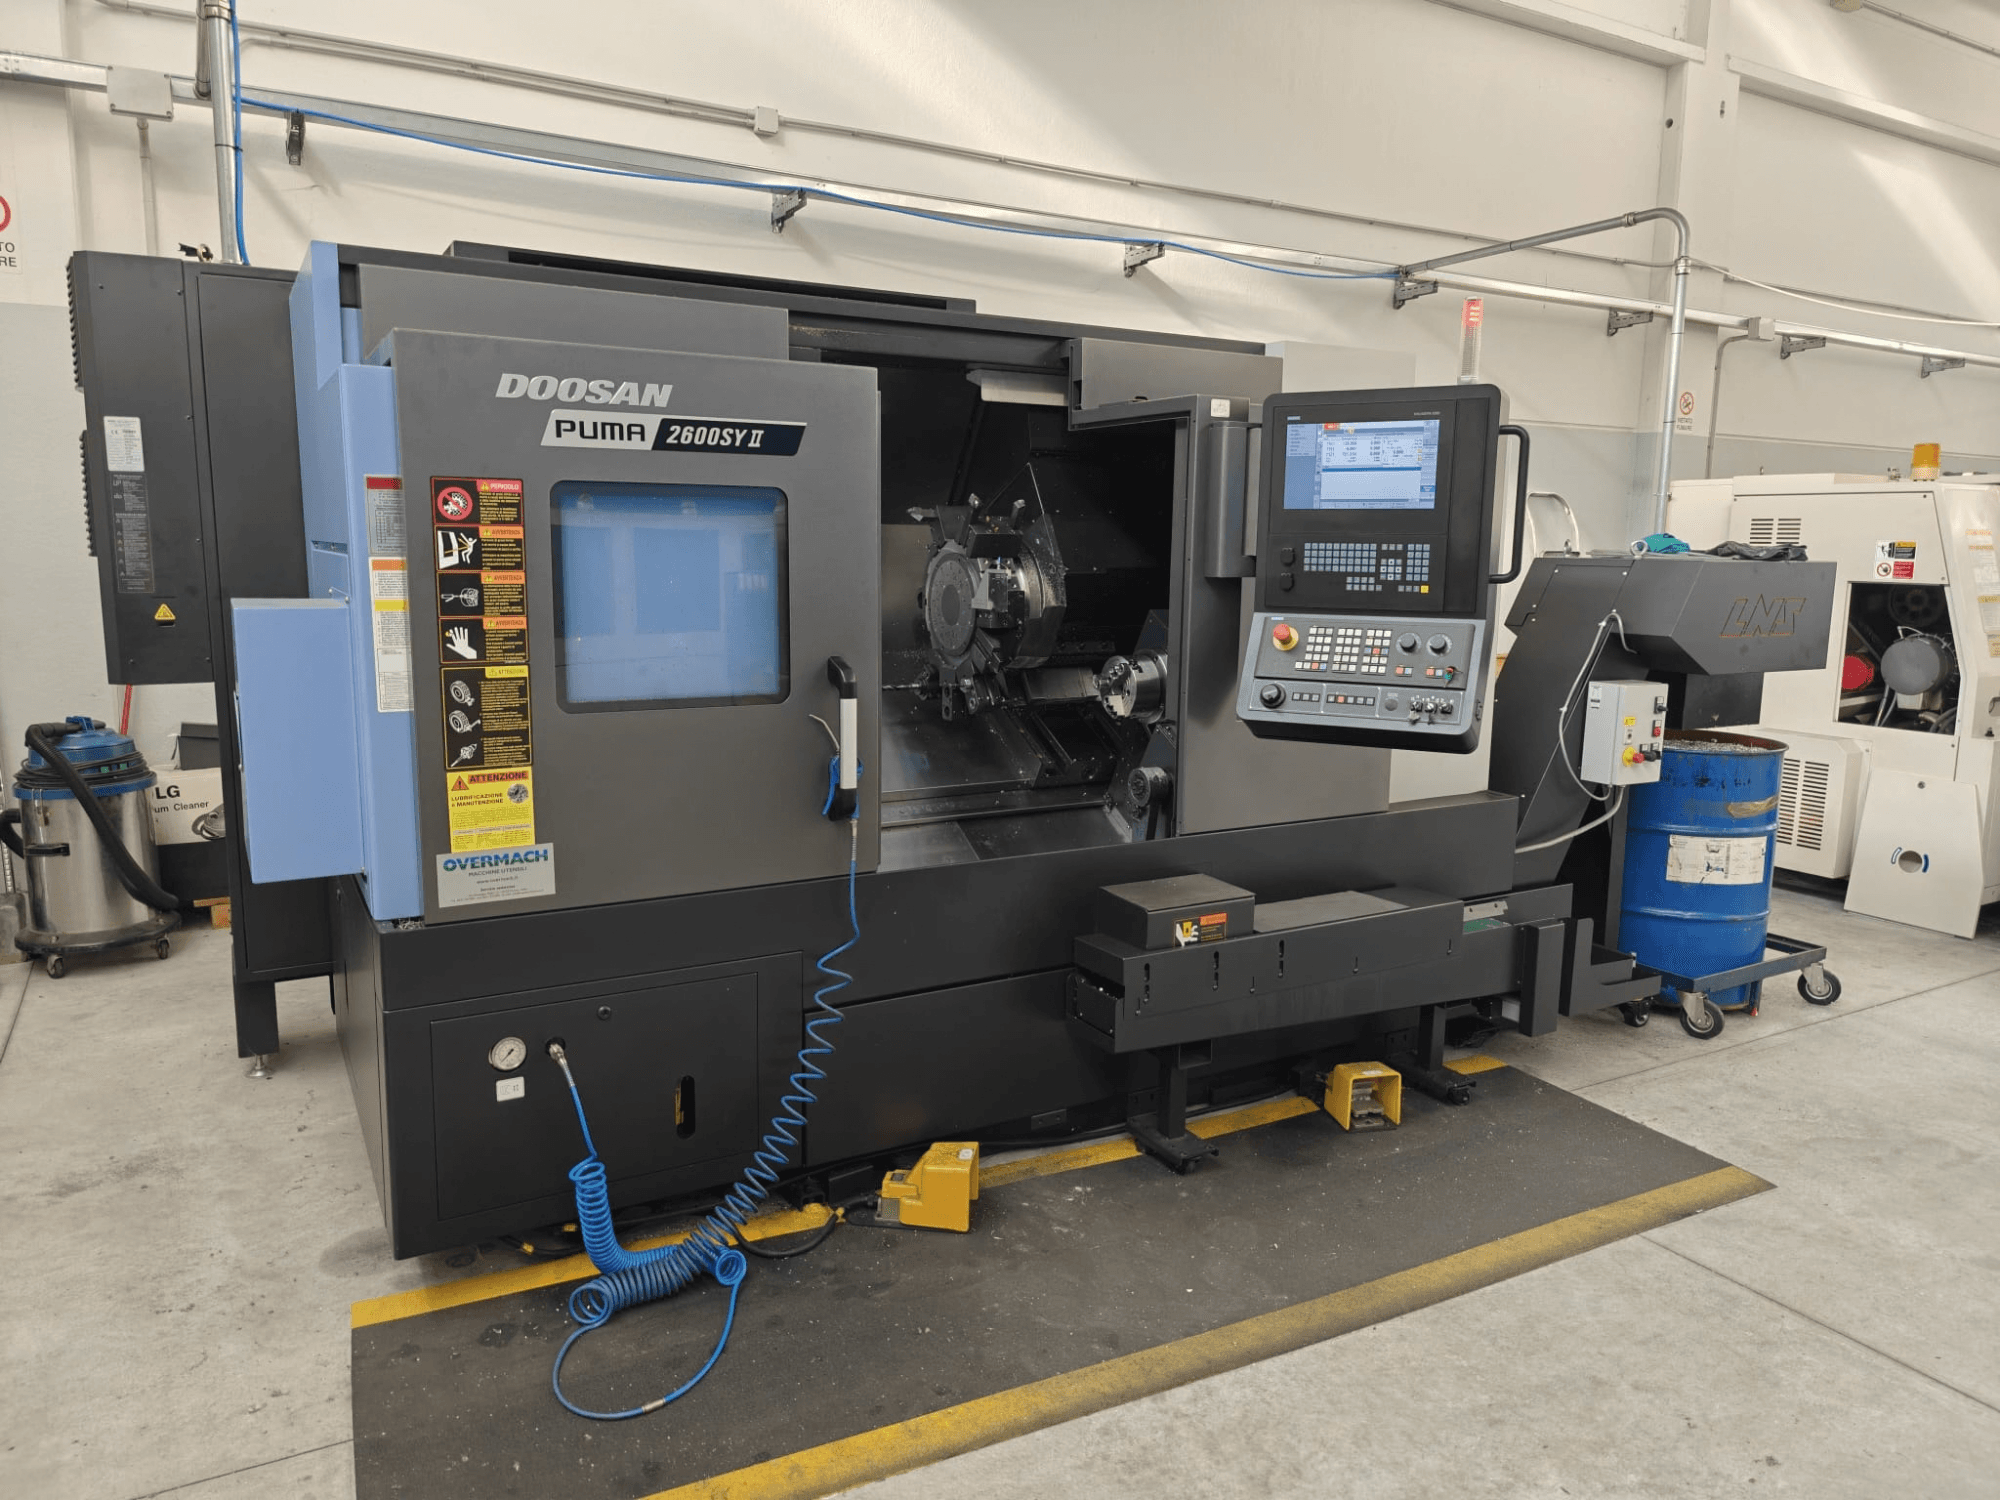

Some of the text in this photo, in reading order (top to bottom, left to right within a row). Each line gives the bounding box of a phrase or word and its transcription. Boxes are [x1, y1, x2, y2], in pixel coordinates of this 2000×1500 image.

[495, 373, 673, 408] DOOSAN
[555, 419, 646, 442] PUMA
[469, 771, 528, 783] ATTENZIONE
[155, 785, 180, 800] LG
[173, 801, 209, 811] Cleaner
[443, 849, 549, 872] OVERMACH
